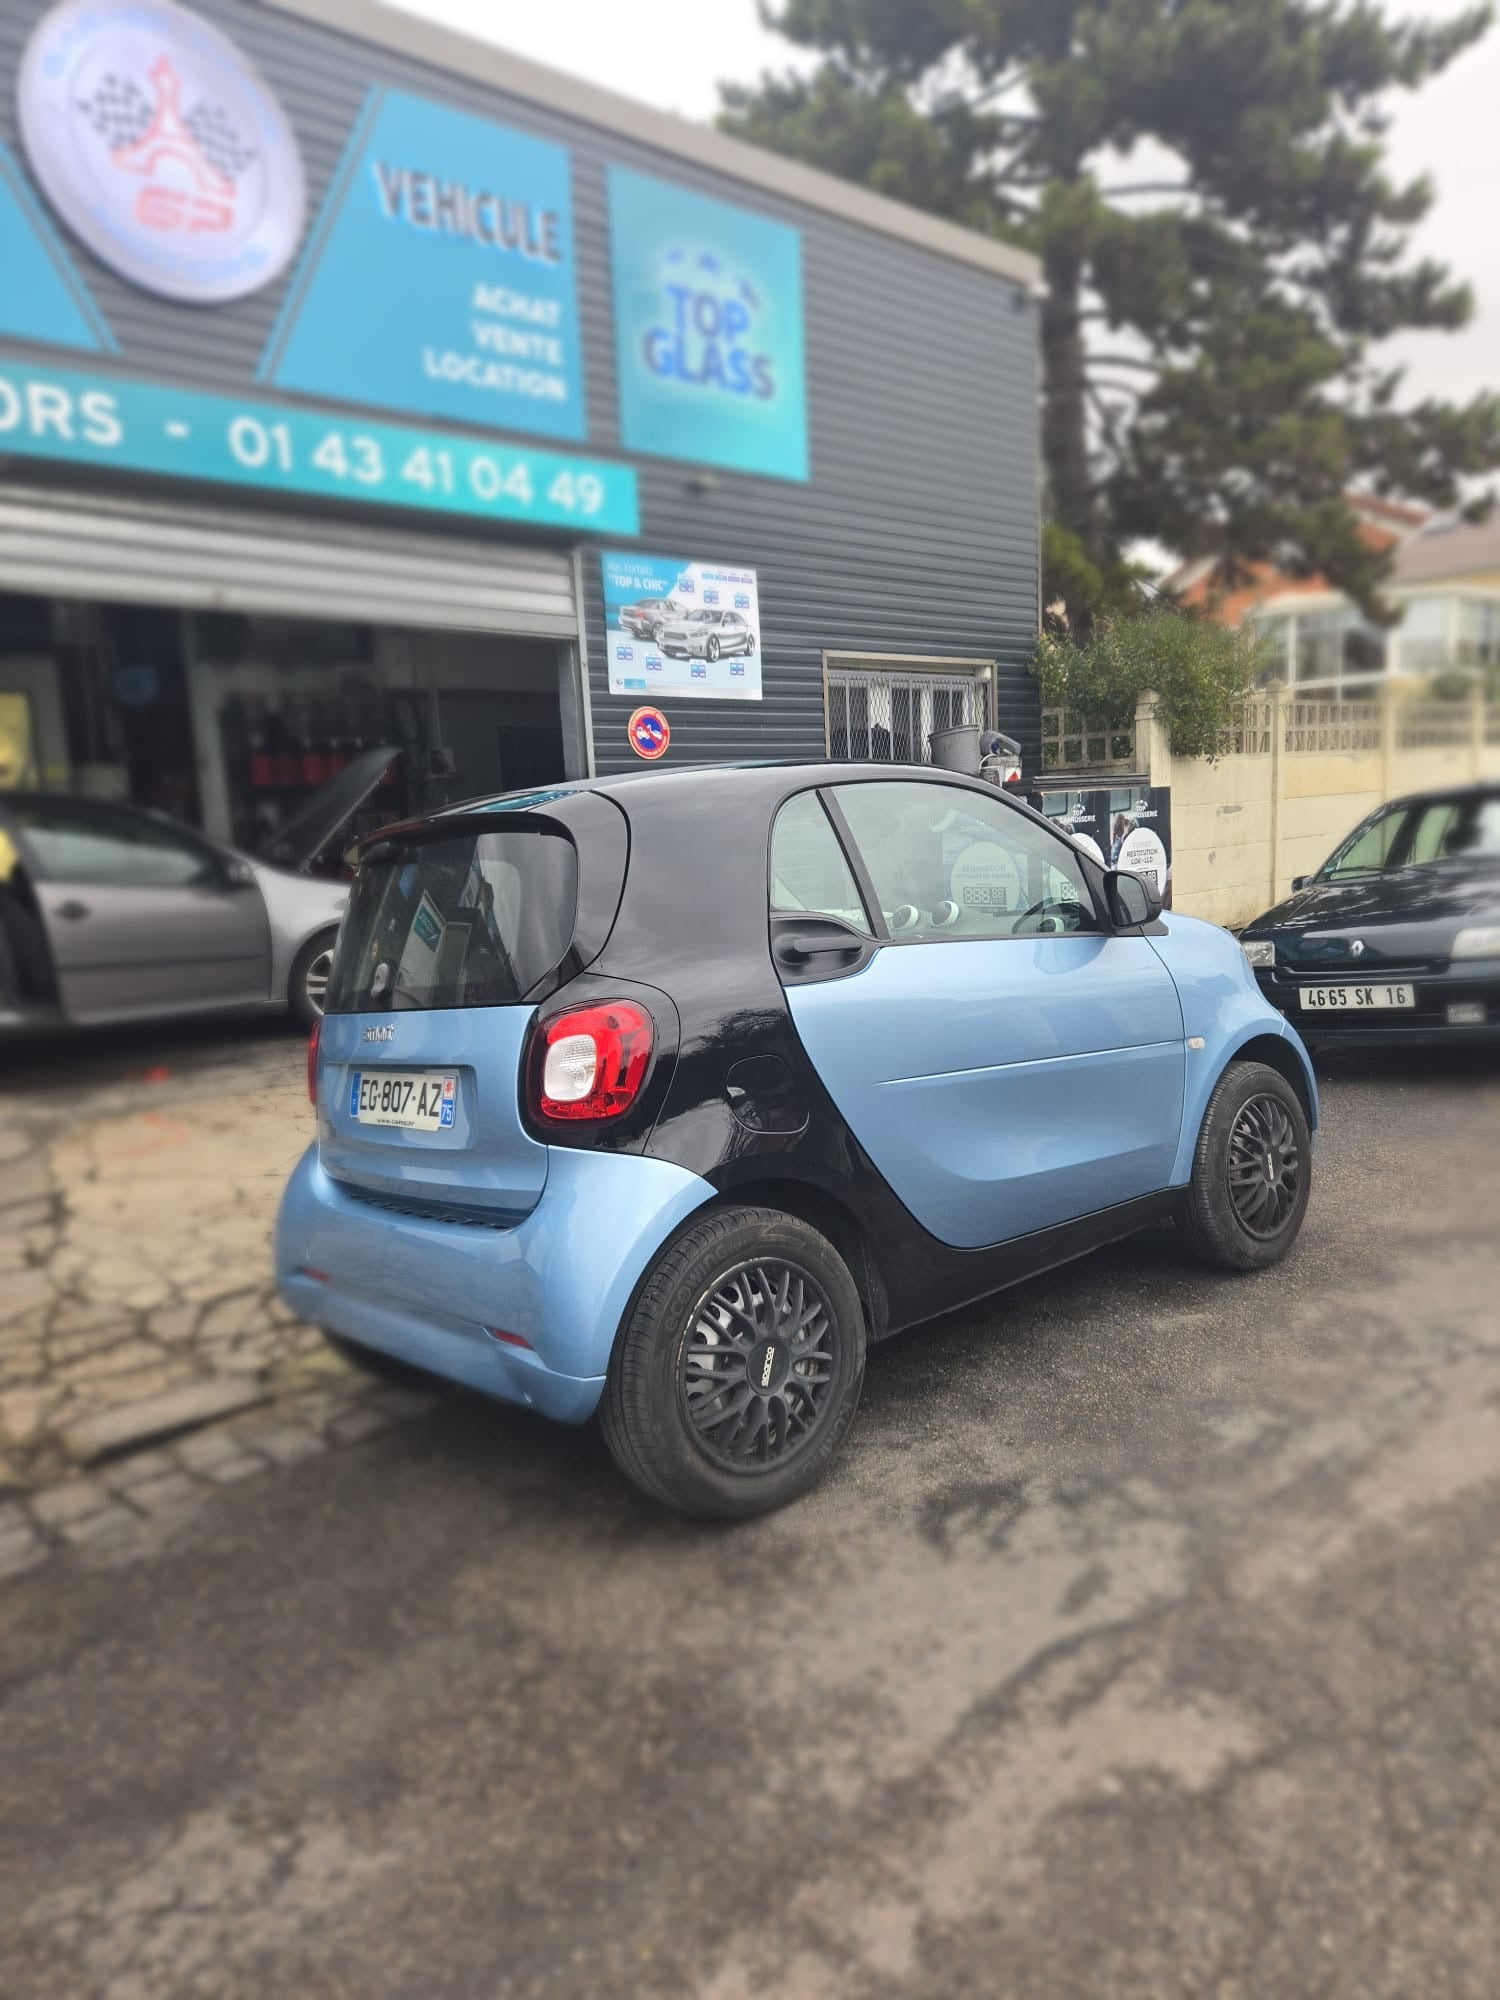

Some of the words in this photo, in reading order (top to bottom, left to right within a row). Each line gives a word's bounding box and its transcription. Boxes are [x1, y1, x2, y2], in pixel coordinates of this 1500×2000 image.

[373, 161, 563, 266] VEHICULE
[472, 282, 561, 327] ACHAT
[665, 283, 751, 344] TOP
[471, 319, 562, 365] VENTE
[643, 325, 776, 401] GLASS
[423, 348, 567, 403] LOCATION
[228, 414, 293, 474] 01
[311, 432, 385, 485] 43
[400, 446, 454, 494] 41
[469, 456, 532, 506] 04
[548, 470, 604, 517] 49
[1072, 809, 1084, 817] TOP
[1126, 848, 1158, 858] RESTITUTION
[1308, 989, 1347, 1007] 4665
[1355, 988, 1375, 1005] SK
[1386, 987, 1405, 1004] 16
[441, 1104, 452, 1121] 75
